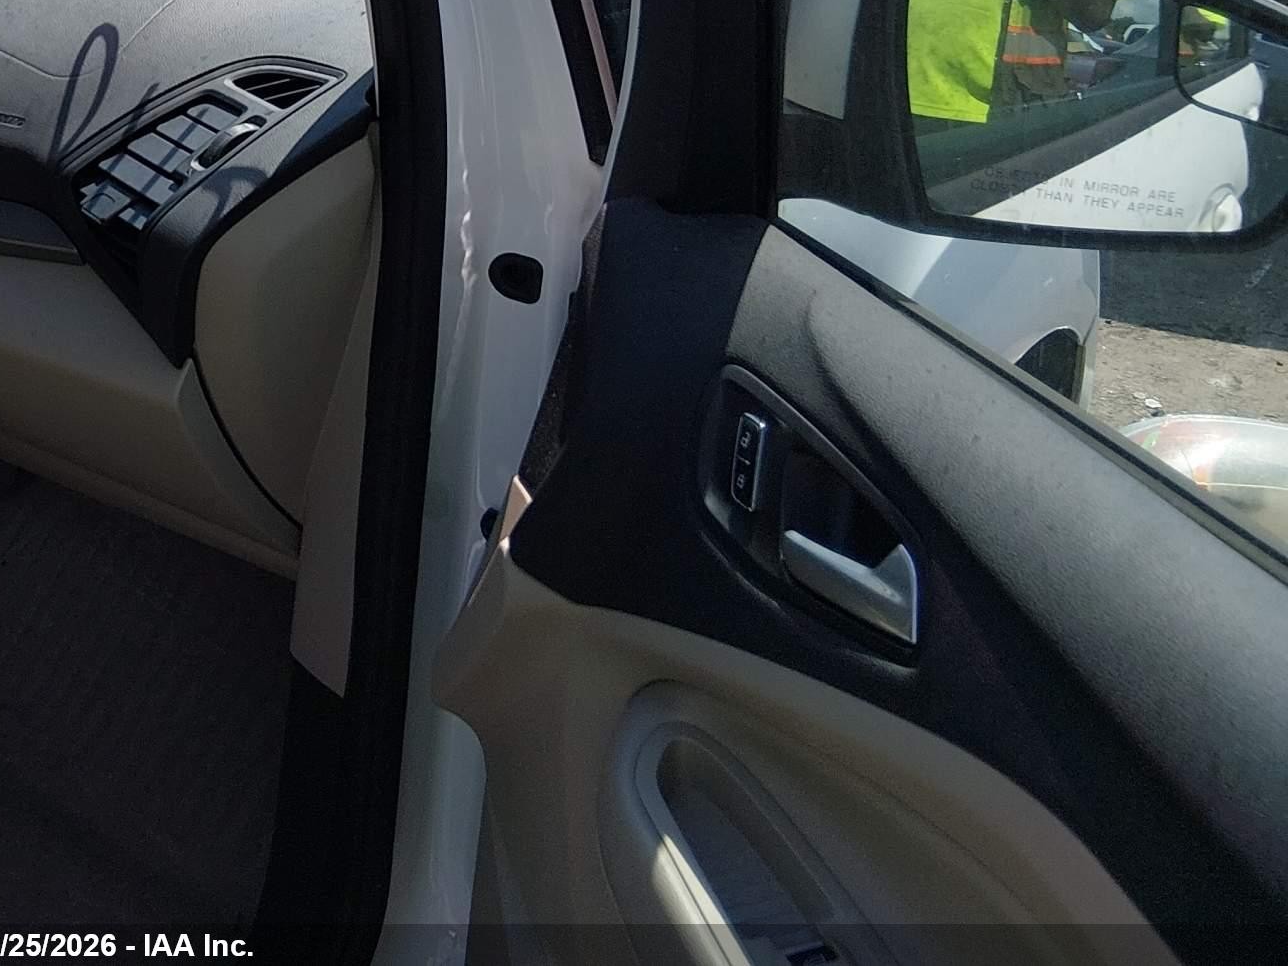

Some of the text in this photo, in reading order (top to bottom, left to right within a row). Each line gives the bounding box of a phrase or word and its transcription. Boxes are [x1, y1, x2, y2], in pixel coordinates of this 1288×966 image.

[1036, 187, 1074, 204] THAN
[1082, 194, 1119, 210] THEY
[1127, 201, 1185, 218] APPEAR
[1059, 177, 1074, 189] IN
[1083, 180, 1140, 198] MIRROR
[1147, 189, 1177, 203] ARE
